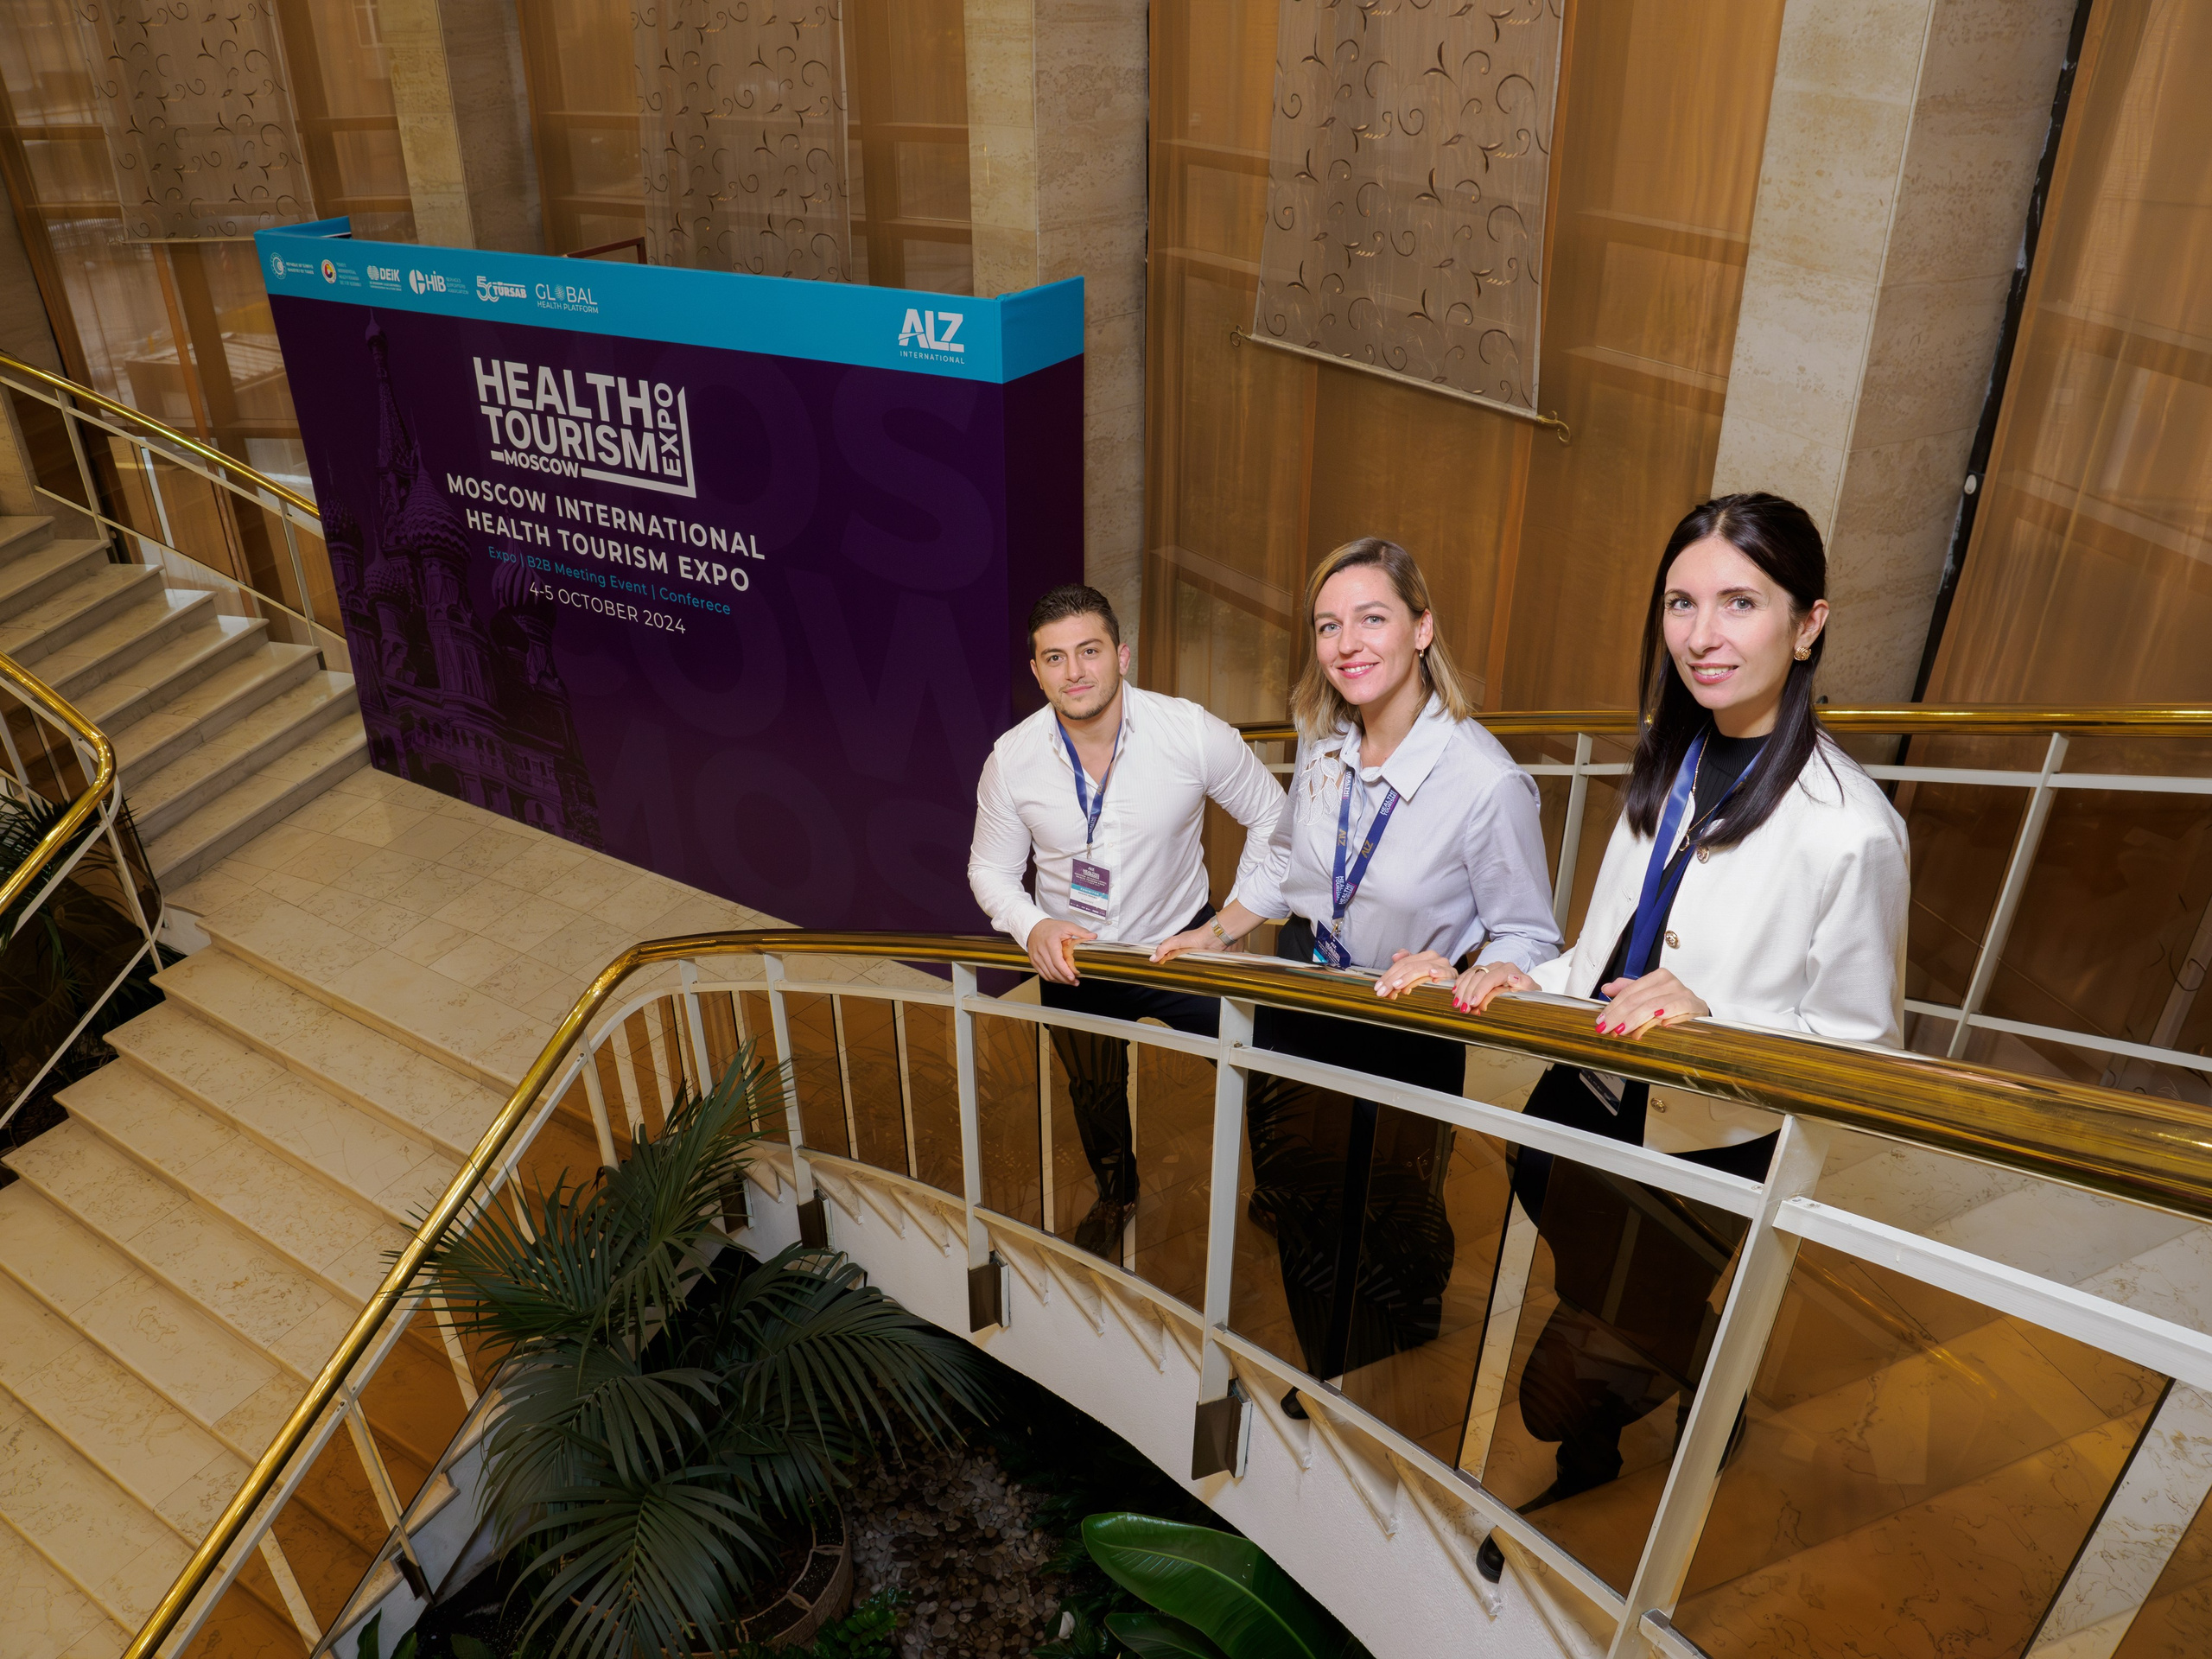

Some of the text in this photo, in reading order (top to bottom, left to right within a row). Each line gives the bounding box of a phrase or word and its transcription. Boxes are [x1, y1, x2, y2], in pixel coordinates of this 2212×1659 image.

[535, 283, 598, 306] GLOBAL
[537, 301, 599, 315] HEALTH PLATFORM
[898, 308, 964, 353] ALZ
[899, 351, 965, 365] INTERNATIONAL
[473, 356, 654, 429] HEALTH
[480, 404, 660, 474] TOURISM
[653, 382, 683, 478] EXPO
[503, 449, 580, 479] MOSCOW
[447, 473, 766, 560] MOSCOW INTERNATIONAL
[465, 508, 750, 592] HEALTH TOURISM EXPO
[488, 546, 731, 616] Expo B2B Meeting Event Conferece
[529, 582, 687, 635] 4-5 OCTOBER 2024
[1379, 791, 1394, 815] HEALTH
[1361, 839, 1374, 859] ALZ
